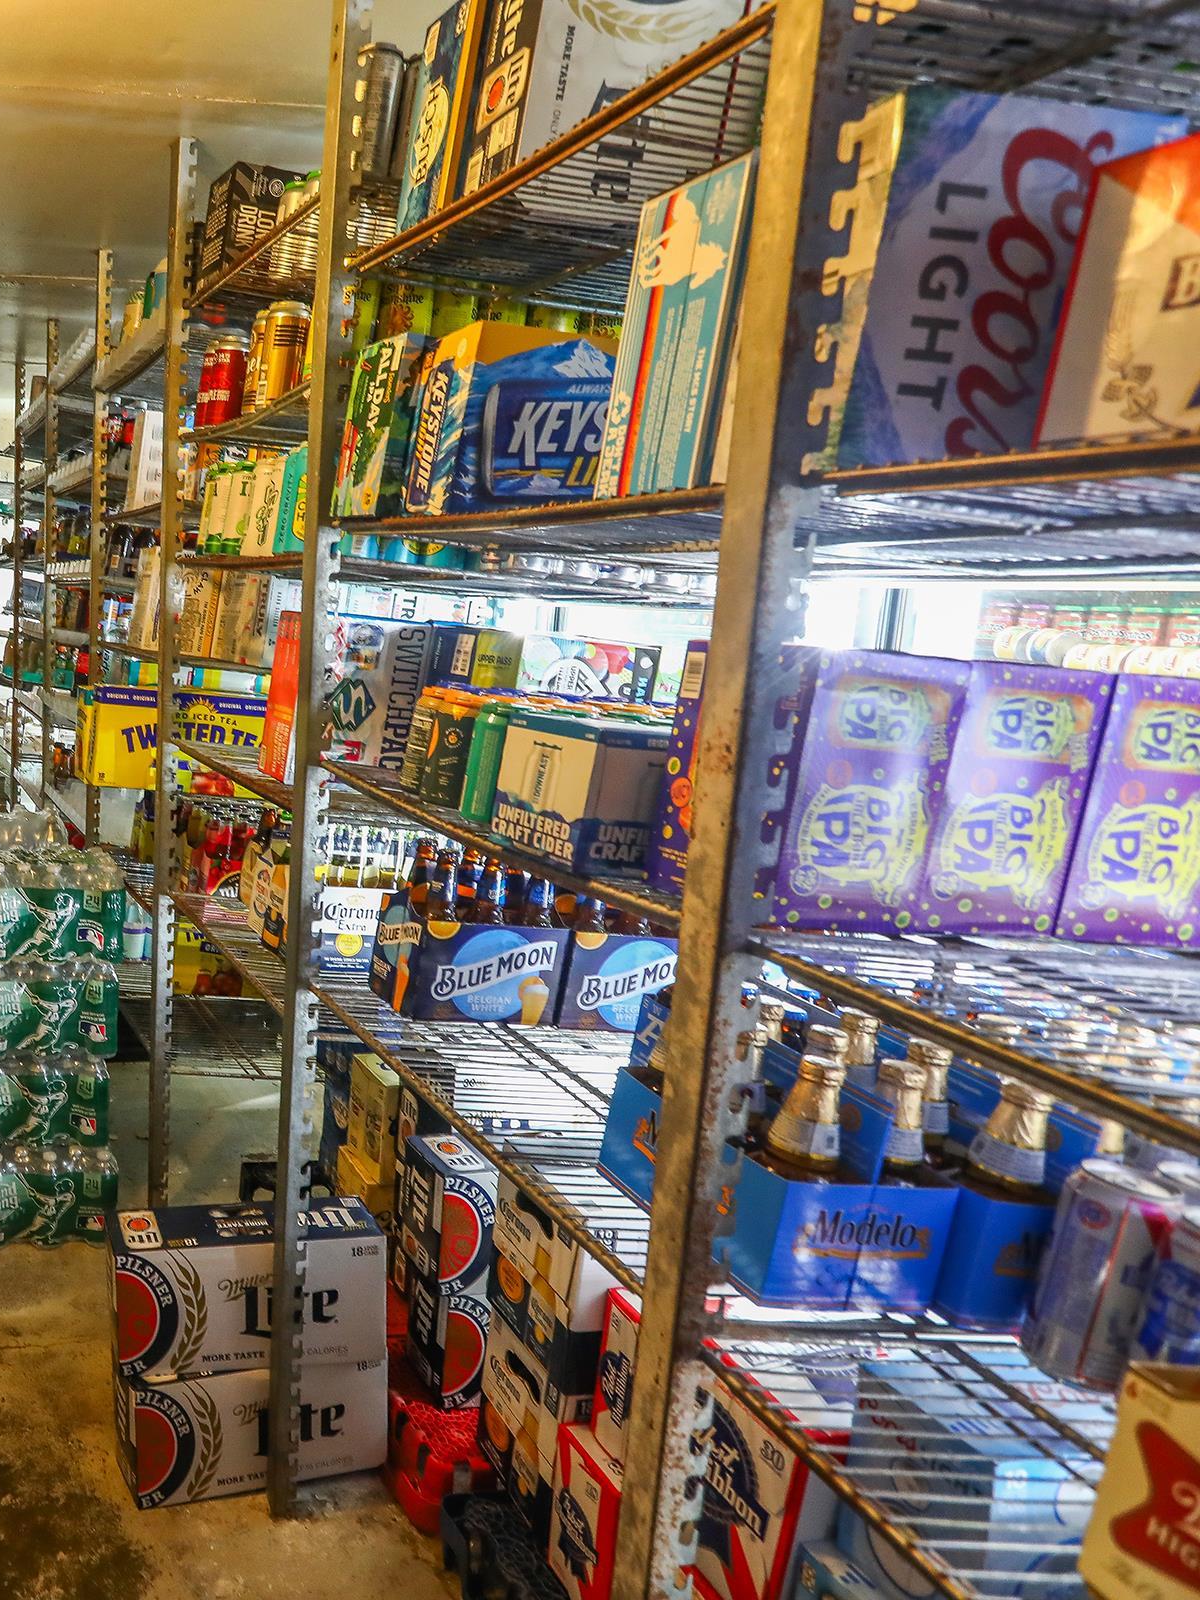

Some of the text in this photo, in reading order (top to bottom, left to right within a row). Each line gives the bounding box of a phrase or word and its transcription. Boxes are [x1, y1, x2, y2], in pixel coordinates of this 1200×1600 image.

[562, 24, 576, 61] MORE
[555, 62, 570, 101] TASTE
[413, 76, 444, 185] BUSCH
[234, 203, 259, 248] DRINK
[254, 207, 277, 242] LON
[897, 180, 988, 412] LIGHT
[365, 381, 376, 403] IPA
[367, 346, 392, 434] ALL DAY
[415, 371, 450, 494] KEYSTONE
[507, 400, 609, 467] KEYS
[192, 572, 209, 596] CLAW
[477, 655, 496, 664] UPPER
[192, 712, 238, 727] ICED TEA
[379, 628, 426, 772] SWITCHPAC
[121, 722, 265, 753] TWTED TE
[535, 753, 551, 802] DOWNEAST
[491, 816, 530, 846] CRAFT
[533, 831, 574, 861] CIDER
[498, 802, 571, 840] UNFILTERED
[810, 793, 856, 868] IPA
[953, 800, 998, 875] IPA
[1002, 805, 1034, 875] BIG
[1101, 811, 1148, 883] IPA
[1149, 816, 1180, 885] BIG
[85, 895, 100, 905] 24
[380, 922, 400, 944] BLUE
[433, 946, 554, 998] BLUE MOON
[580, 962, 678, 1009] BLUE MO
[467, 994, 512, 1005] BELGIAN
[471, 1003, 505, 1013] WHITE
[612, 1004, 640, 1014] BELG
[86, 1179, 99, 1190] 24
[444, 1176, 496, 1227] PILSNER
[813, 1209, 918, 1249] Modelo
[351, 1246, 363, 1257] 18
[115, 1253, 174, 1308] PILSNER
[240, 1286, 340, 1339] Lie
[450, 1295, 490, 1333] PILSN
[122, 1359, 148, 1377] ER
[201, 1351, 266, 1363] MORE TASTE
[356, 1360, 368, 1371] 18
[136, 1390, 190, 1438] PILSNER
[254, 1404, 346, 1456] Lte
[760, 1437, 786, 1472] 30
[216, 1471, 268, 1487] MORE TAS
[707, 1458, 763, 1536] ibbon
[140, 1491, 165, 1509] ER
[1146, 1515, 1200, 1569] HIG
